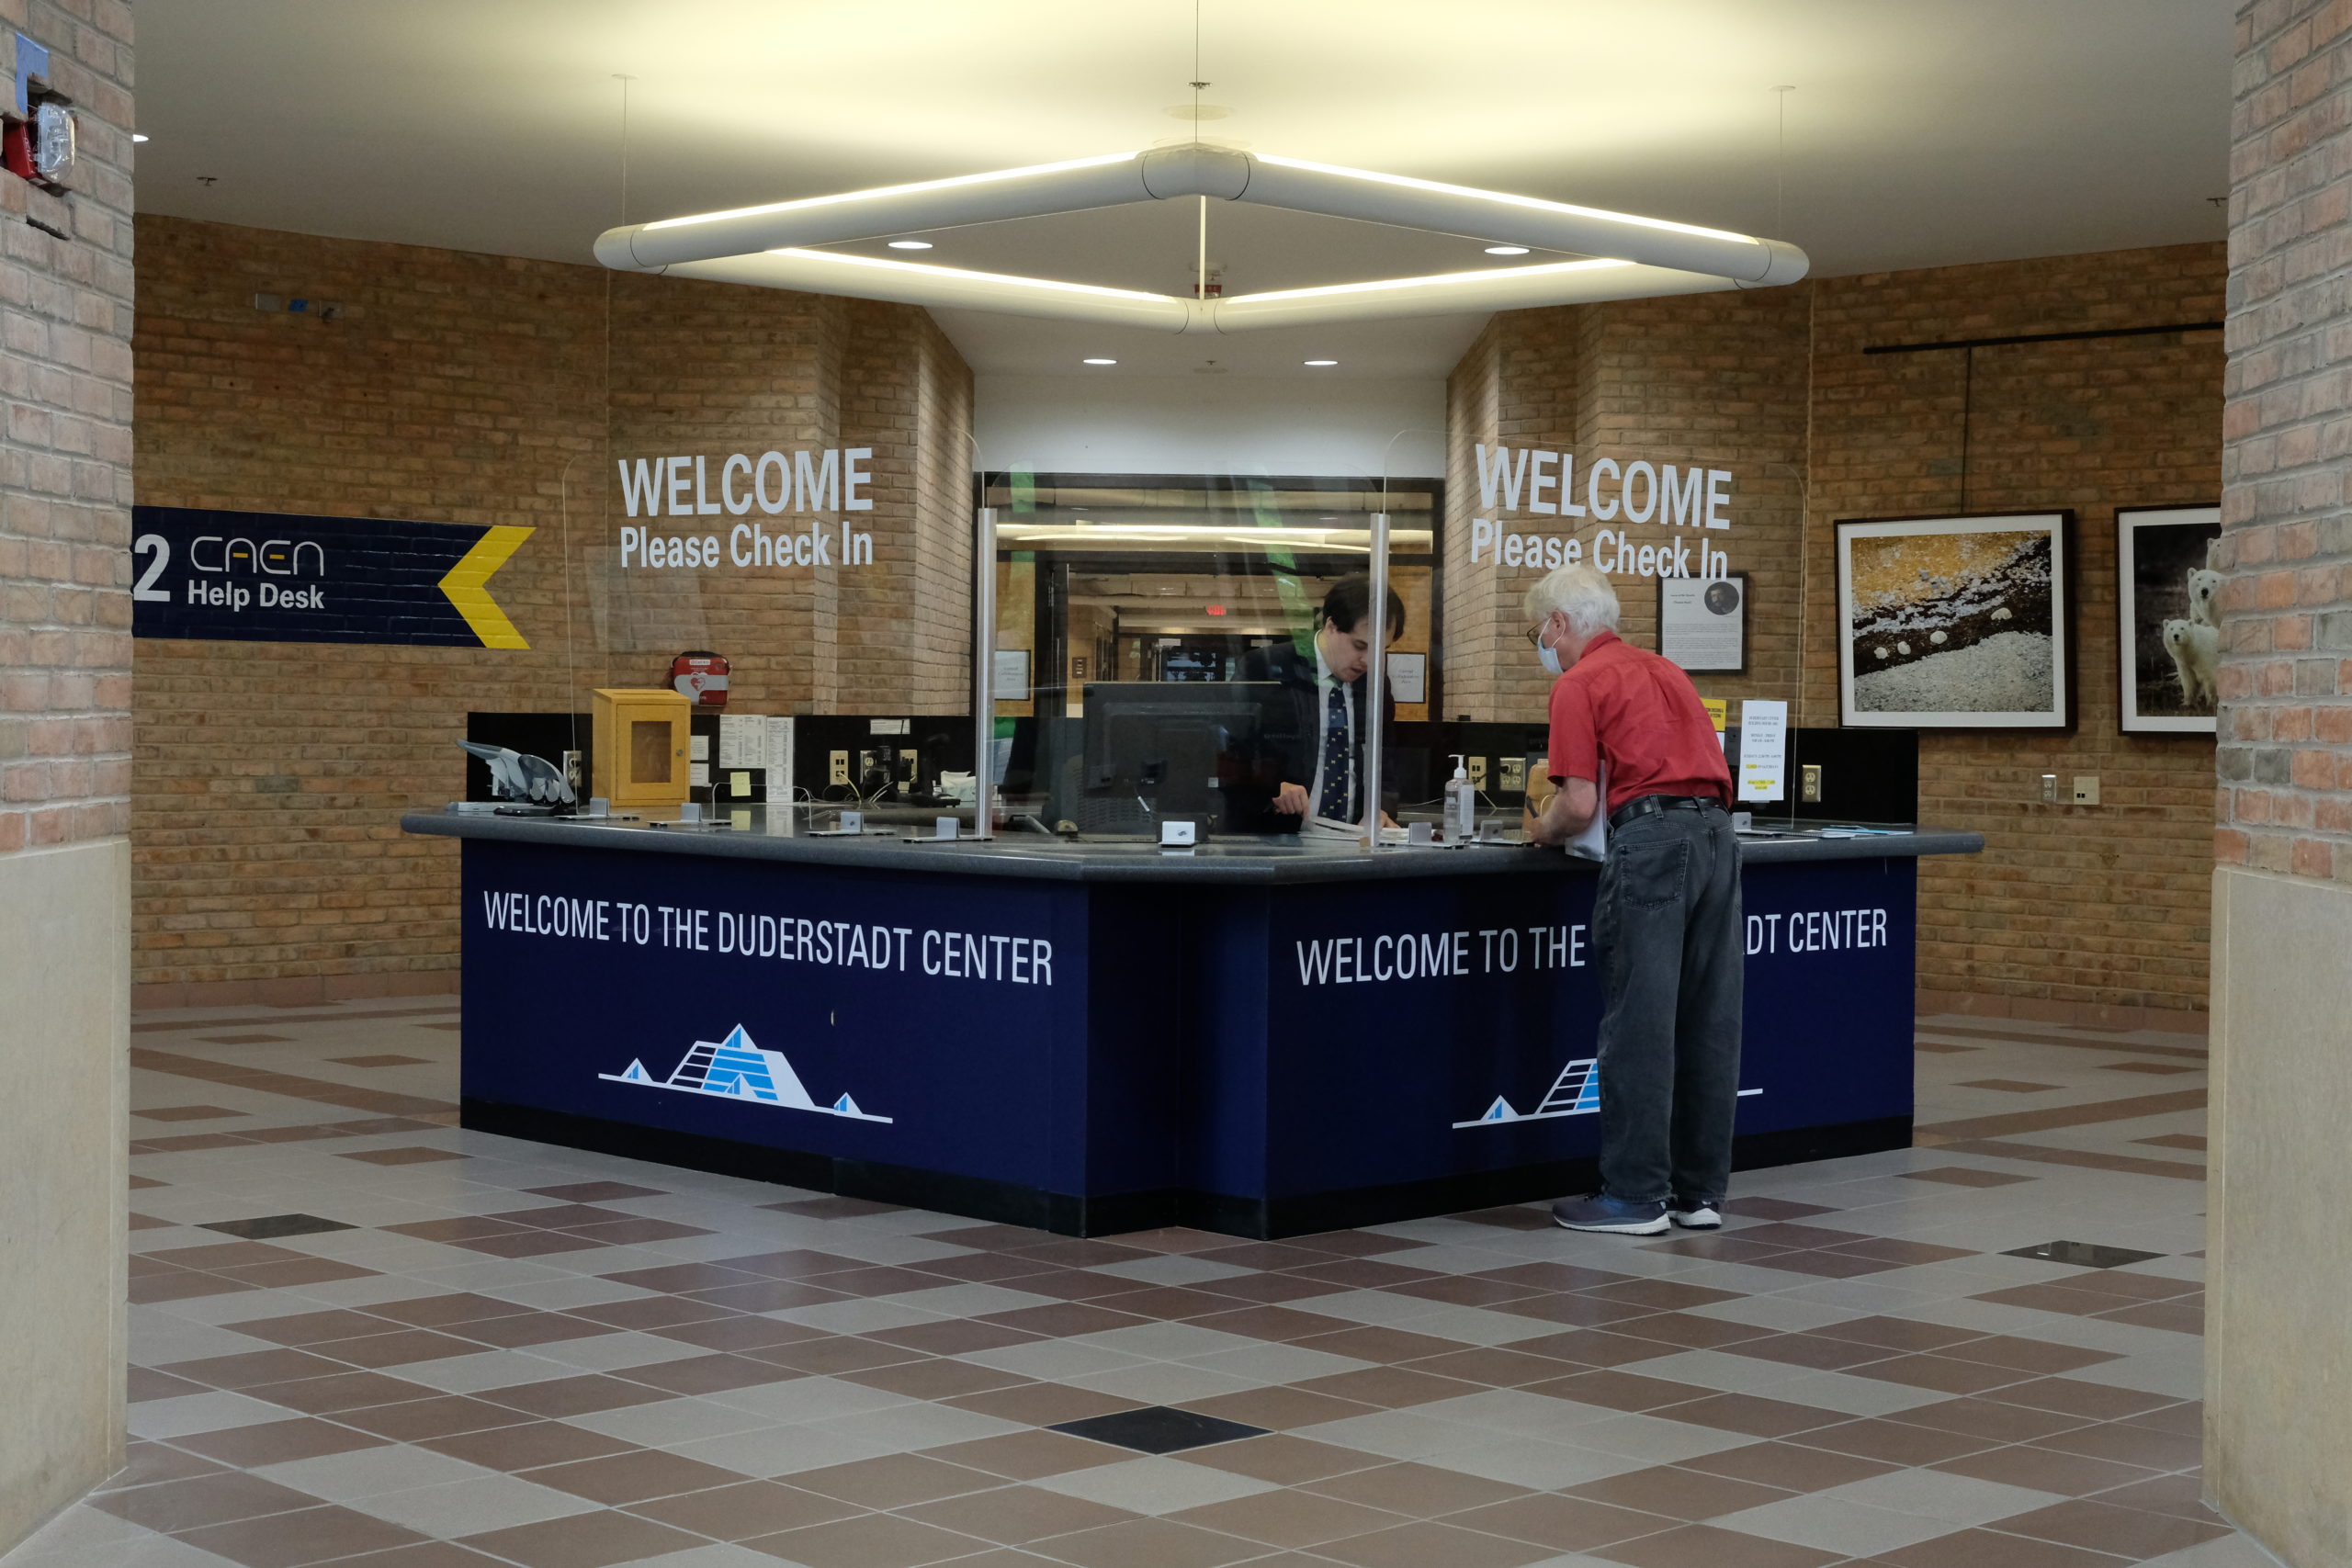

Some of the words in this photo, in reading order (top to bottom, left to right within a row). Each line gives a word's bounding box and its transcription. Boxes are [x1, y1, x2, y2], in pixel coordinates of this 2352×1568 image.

[617, 447, 874, 517] WELCOME
[1475, 443, 1733, 530] WELCOME
[133, 534, 171, 603] 2
[620, 525, 720, 569] Please
[729, 522, 831, 568] Check
[842, 521, 873, 567] In
[1470, 518, 1582, 570] Please
[1592, 528, 1691, 580] Check
[1700, 537, 1729, 581] In
[187, 579, 251, 613] Help
[258, 582, 325, 609] Desk
[483, 890, 610, 941] WELCOME
[616, 902, 650, 945] TO
[658, 906, 709, 952] THE
[718, 911, 912, 972] DUDERSTADT
[922, 930, 1052, 986] CENTER
[1296, 931, 1470, 986] WELCOME
[1478, 929, 1519, 974] TO
[1529, 924, 1587, 970] THE
[1789, 908, 1887, 953] CENTER
